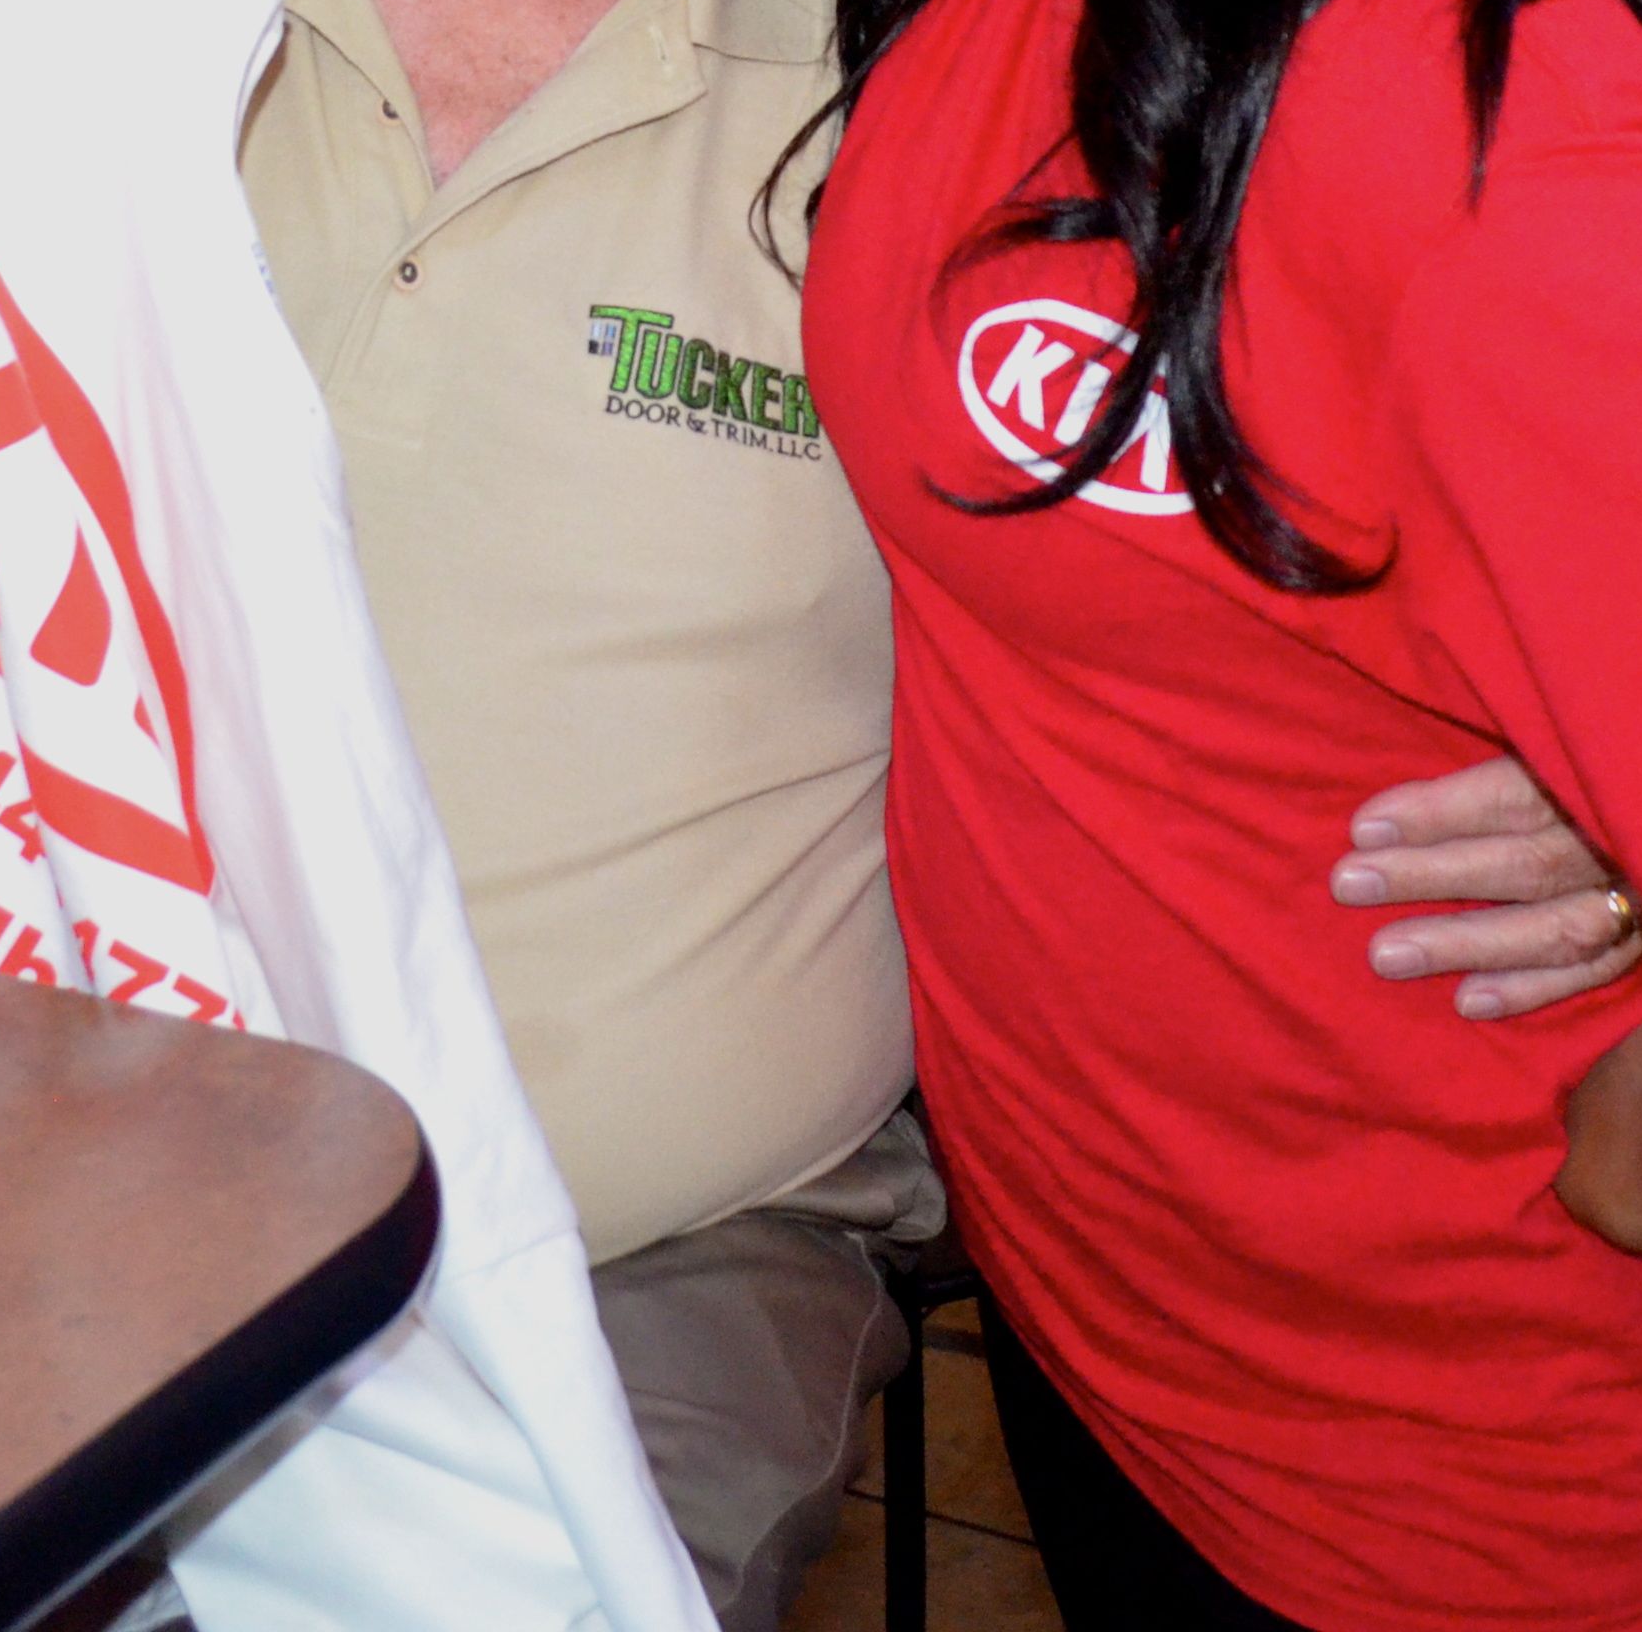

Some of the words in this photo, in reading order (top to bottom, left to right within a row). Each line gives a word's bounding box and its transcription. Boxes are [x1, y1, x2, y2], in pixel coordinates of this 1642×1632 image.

[590, 304, 820, 439] TUCKER
[606, 394, 682, 428] DOOR
[686, 412, 707, 434] &
